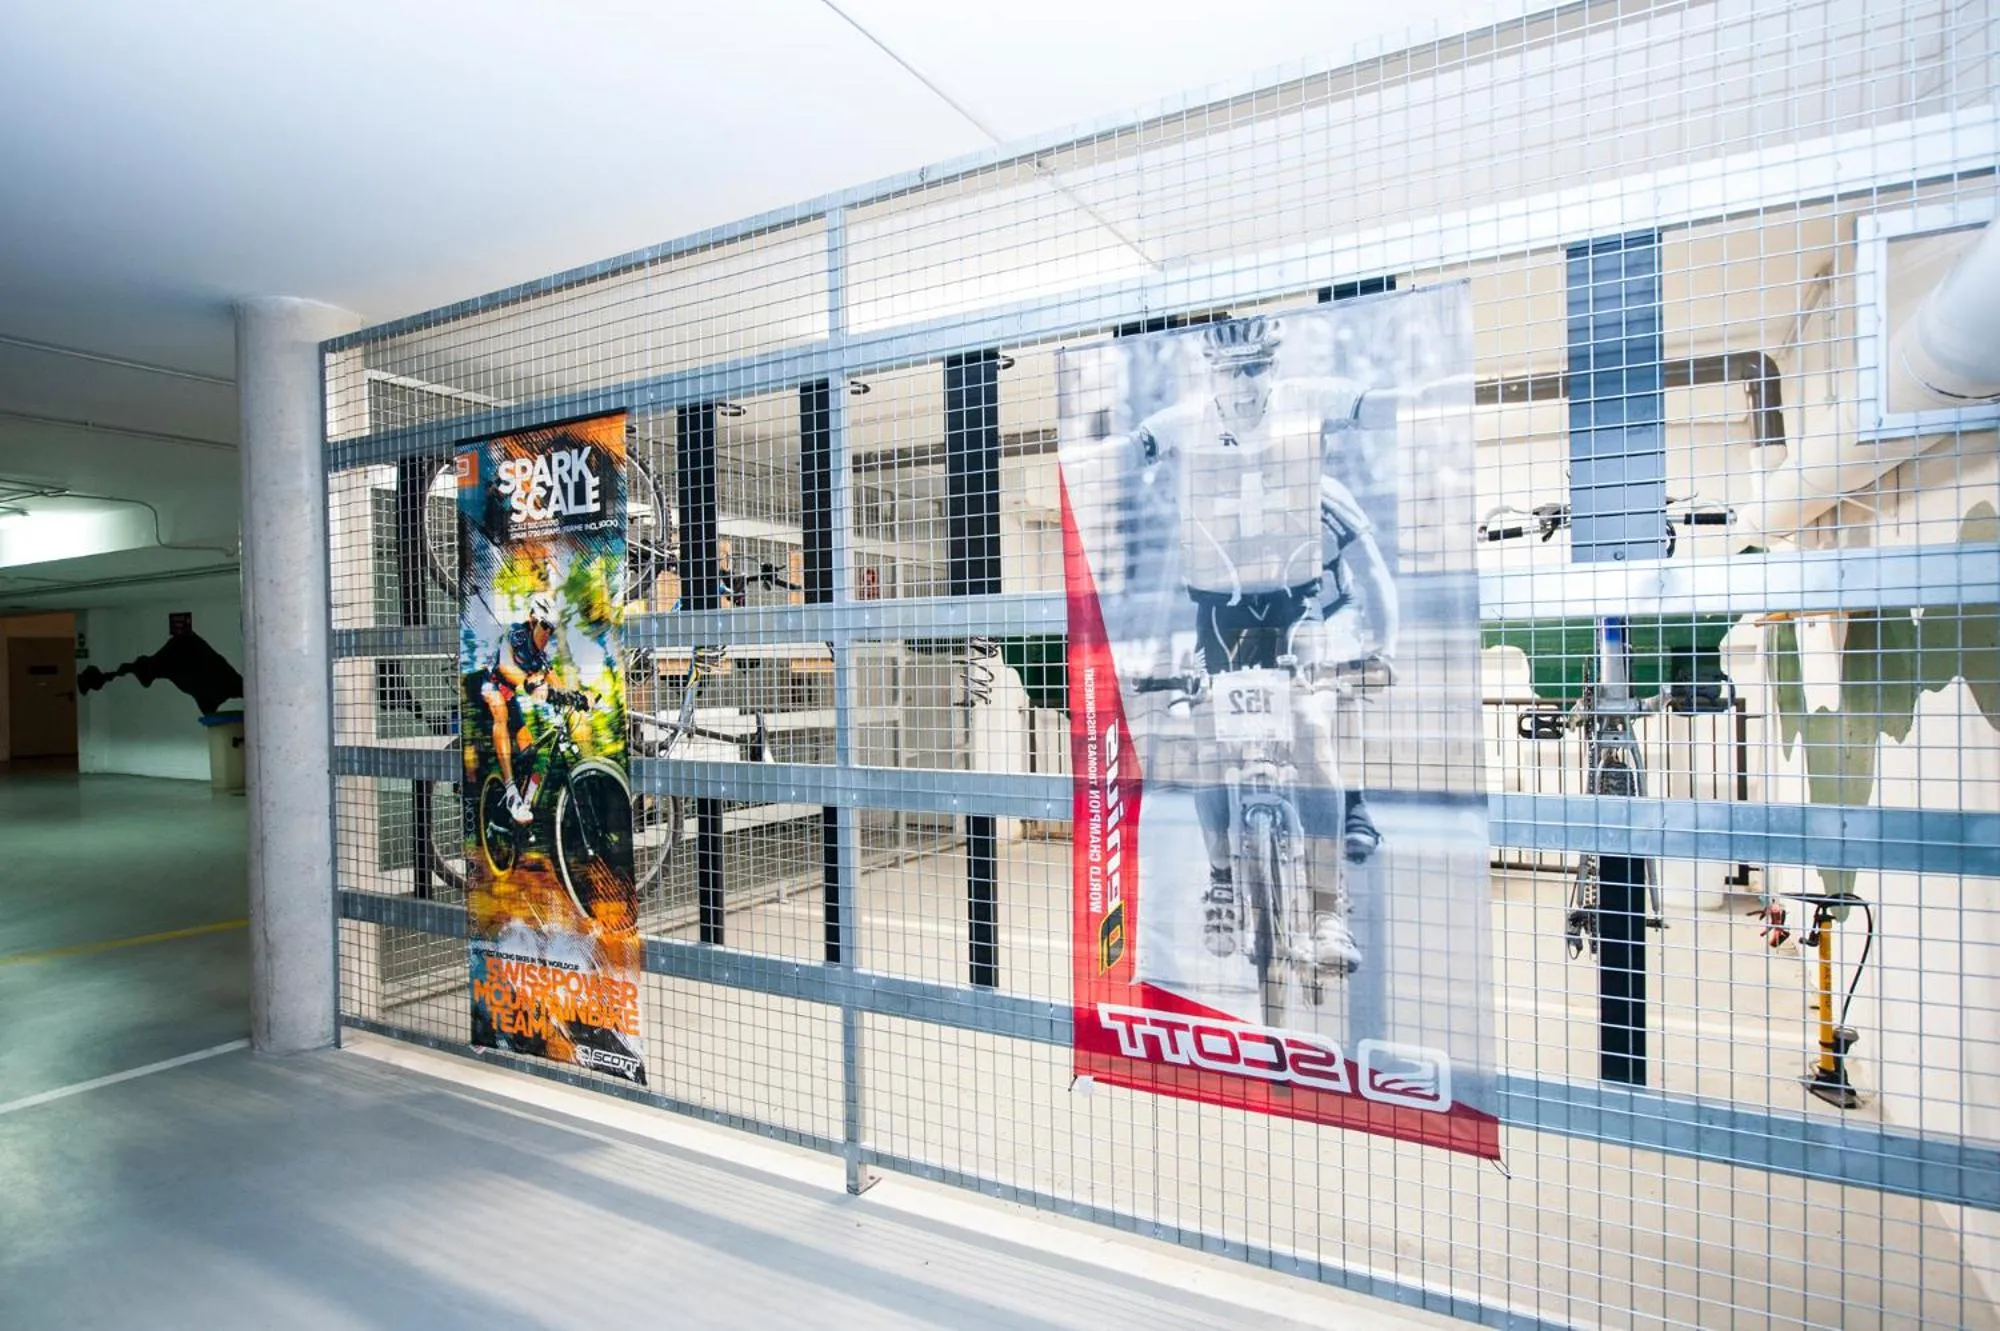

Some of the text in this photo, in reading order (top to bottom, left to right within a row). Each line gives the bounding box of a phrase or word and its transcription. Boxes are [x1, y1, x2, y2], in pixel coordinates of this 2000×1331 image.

[498, 446, 593, 494] SPARK
[510, 476, 600, 522] SCALE
[486, 957, 639, 1009] SWISSPOWER
[473, 978, 640, 1037] MOUNTAINBIKE
[490, 1005, 549, 1040] TEAM
[592, 1049, 641, 1073] SCOTT
